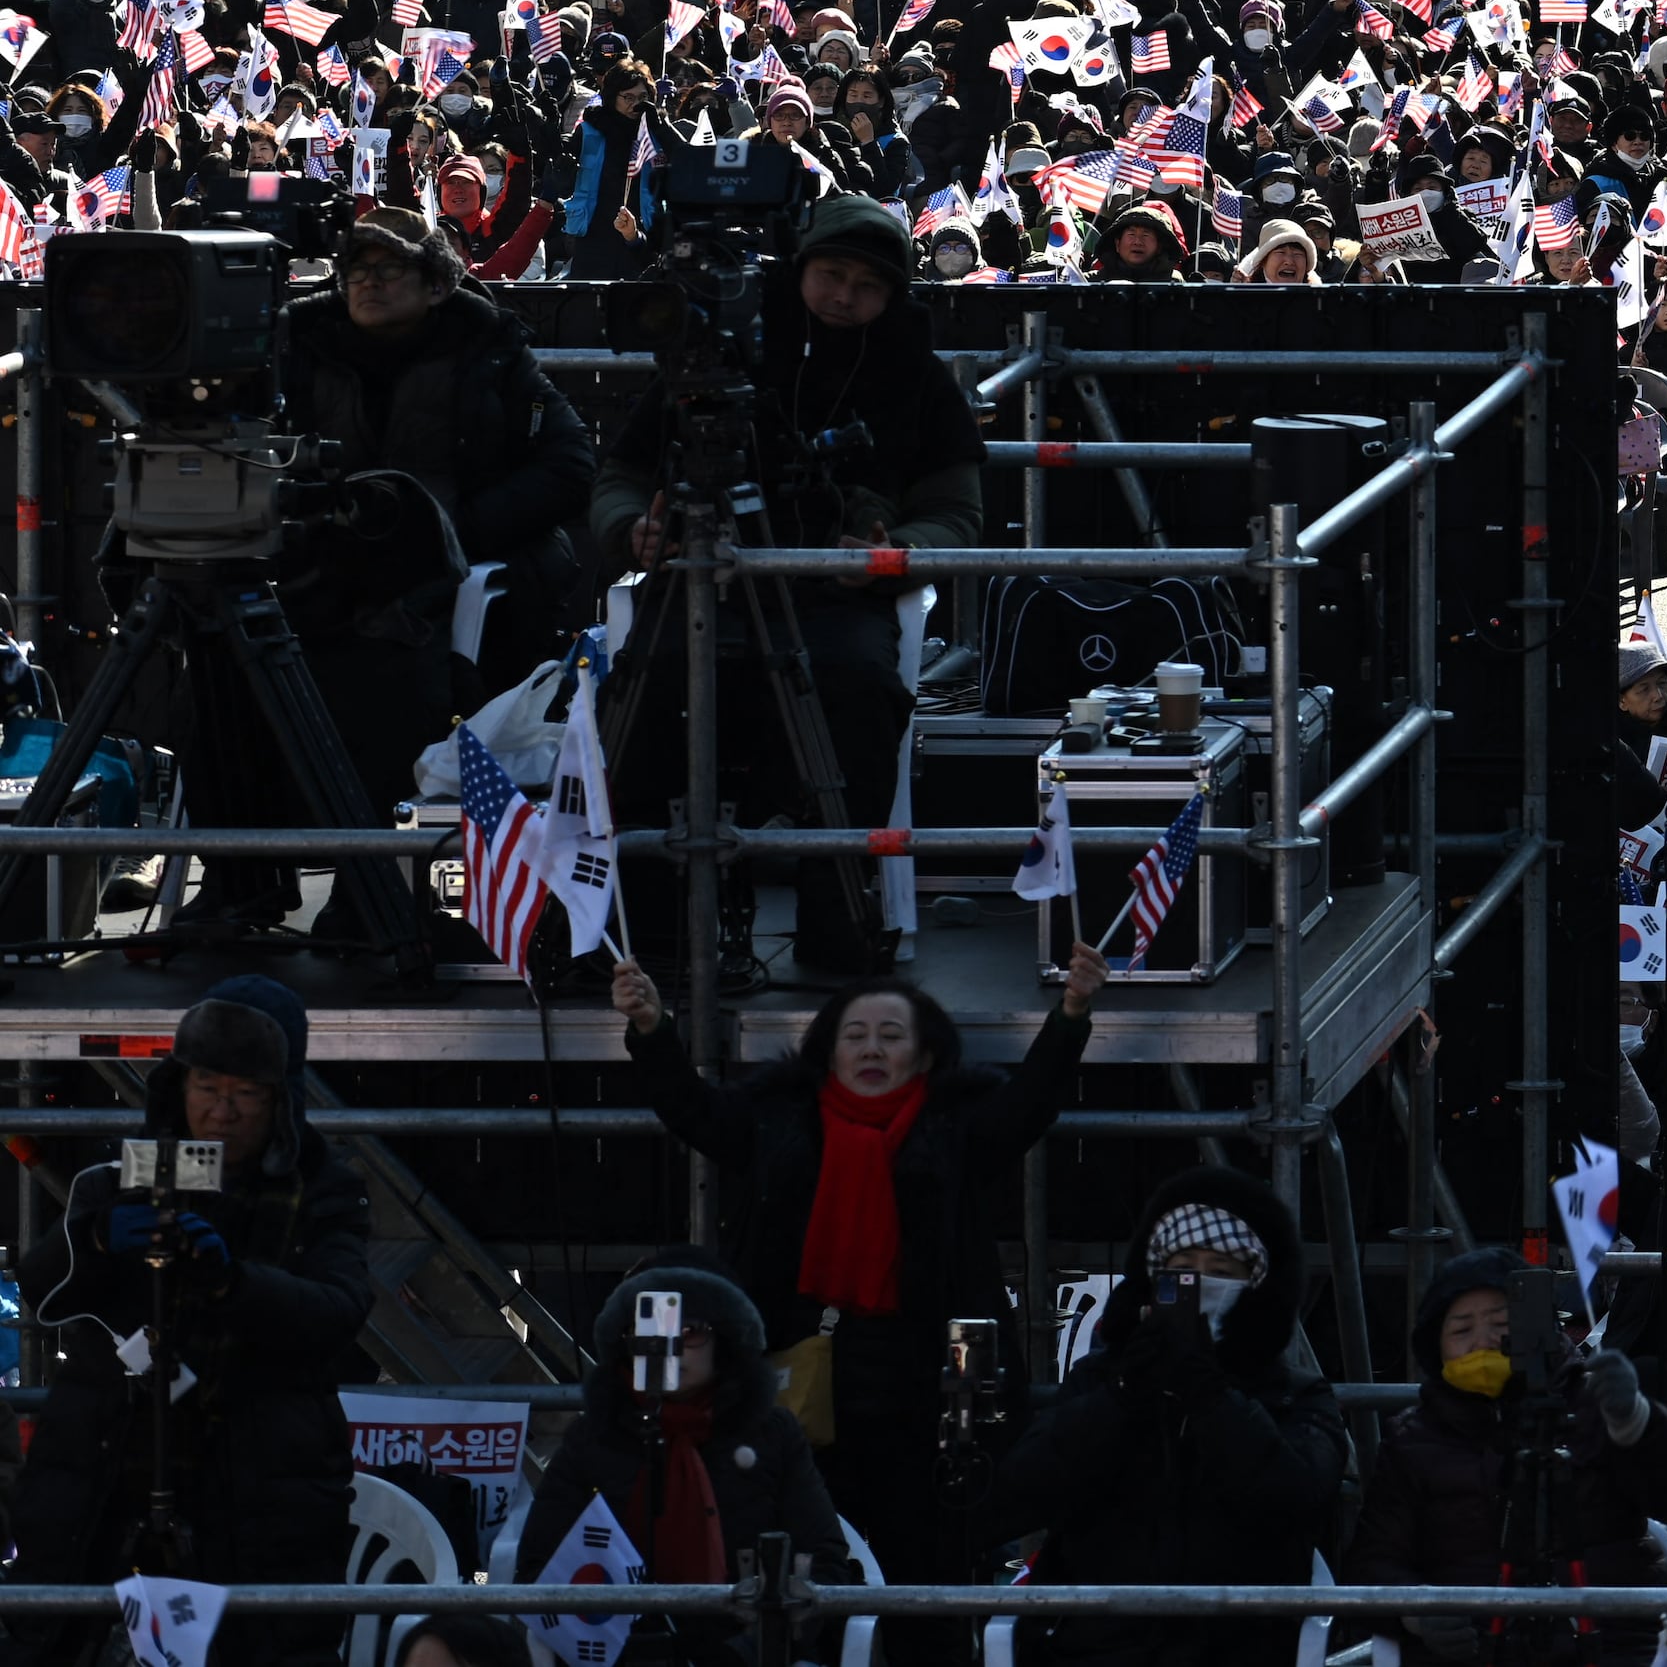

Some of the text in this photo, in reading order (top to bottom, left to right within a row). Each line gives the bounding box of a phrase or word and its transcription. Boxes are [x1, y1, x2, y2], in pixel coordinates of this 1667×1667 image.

[724, 145, 739, 163] 3
[707, 177, 750, 185] SONY
[1361, 208, 1420, 237] 새해 소원은
[352, 1429, 517, 1467] 새해 소원은
